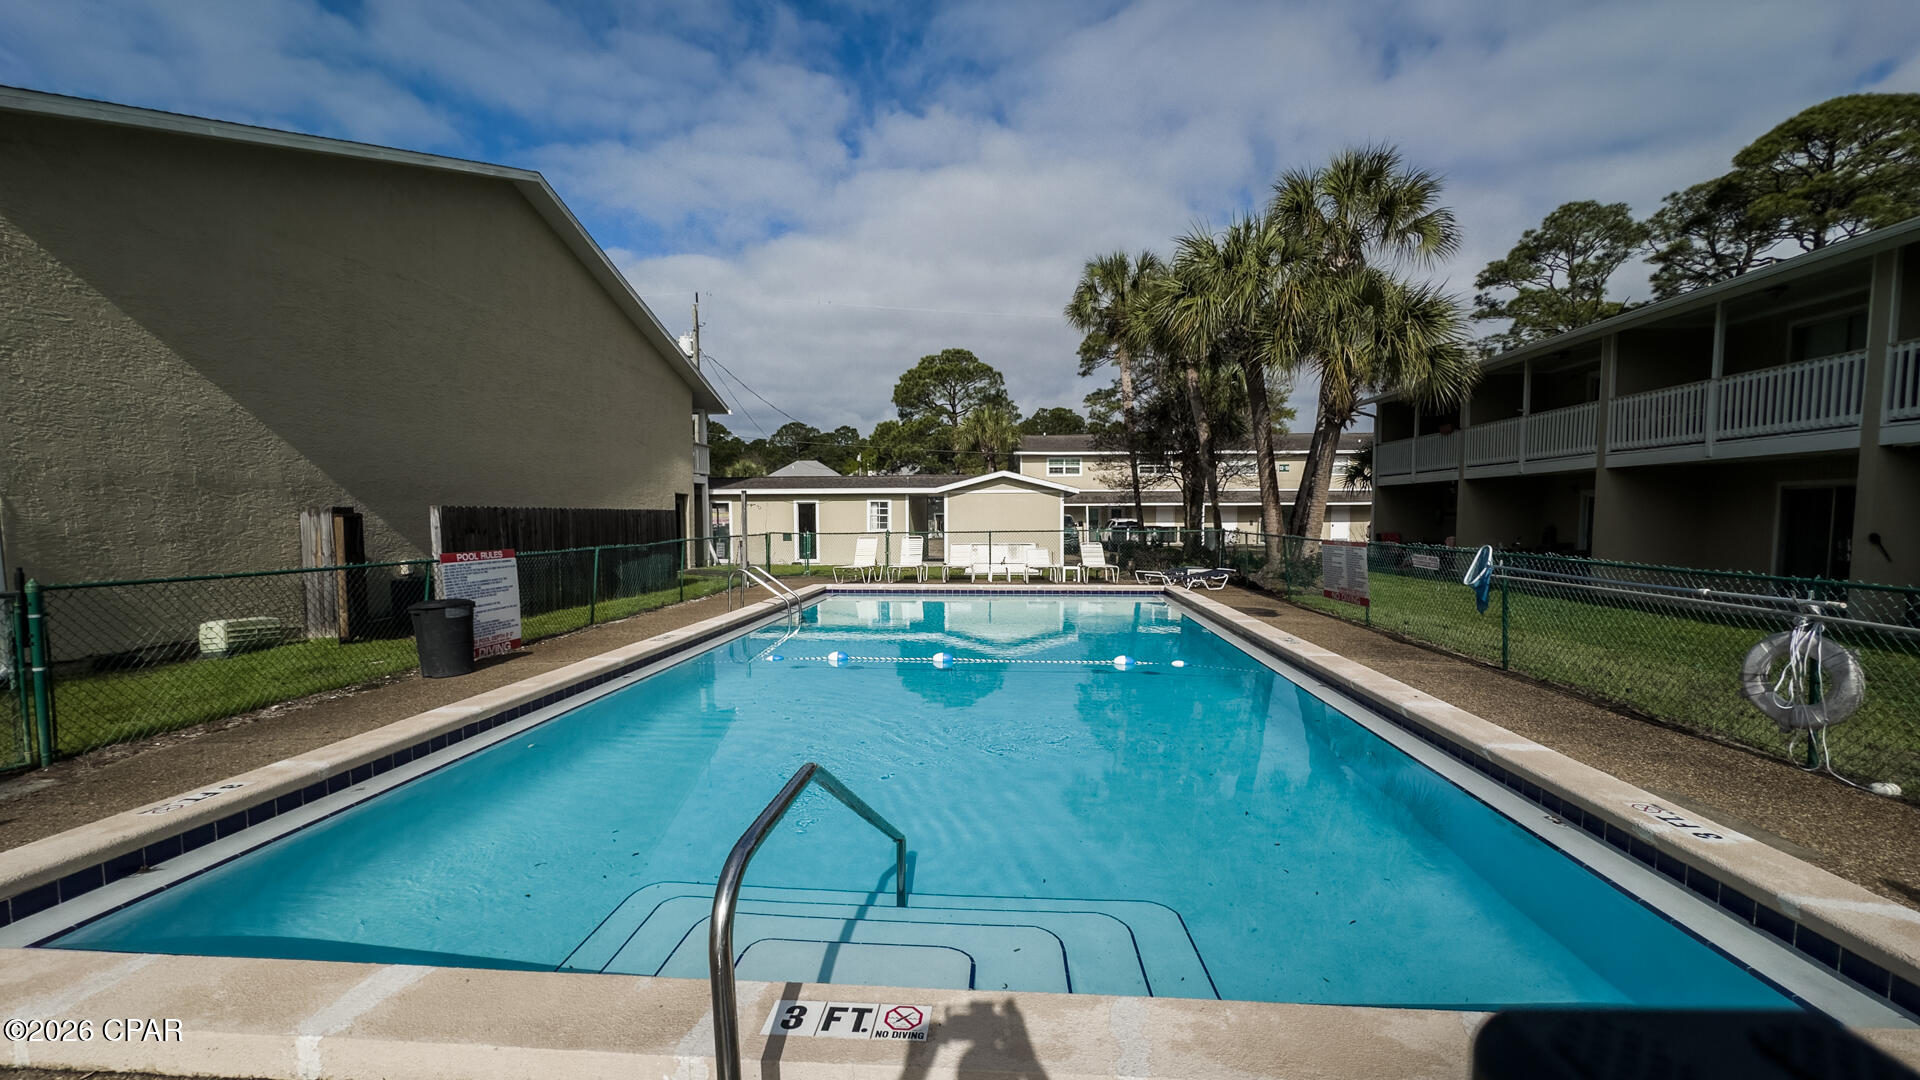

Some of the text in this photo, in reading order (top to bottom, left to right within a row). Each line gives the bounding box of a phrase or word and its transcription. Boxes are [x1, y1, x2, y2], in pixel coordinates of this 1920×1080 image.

[456, 550, 503, 562] POOL RULES
[479, 641, 511, 657] DIVING
[780, 1005, 873, 1033] 3 FT.
[892, 1031, 925, 1040] DIVING
